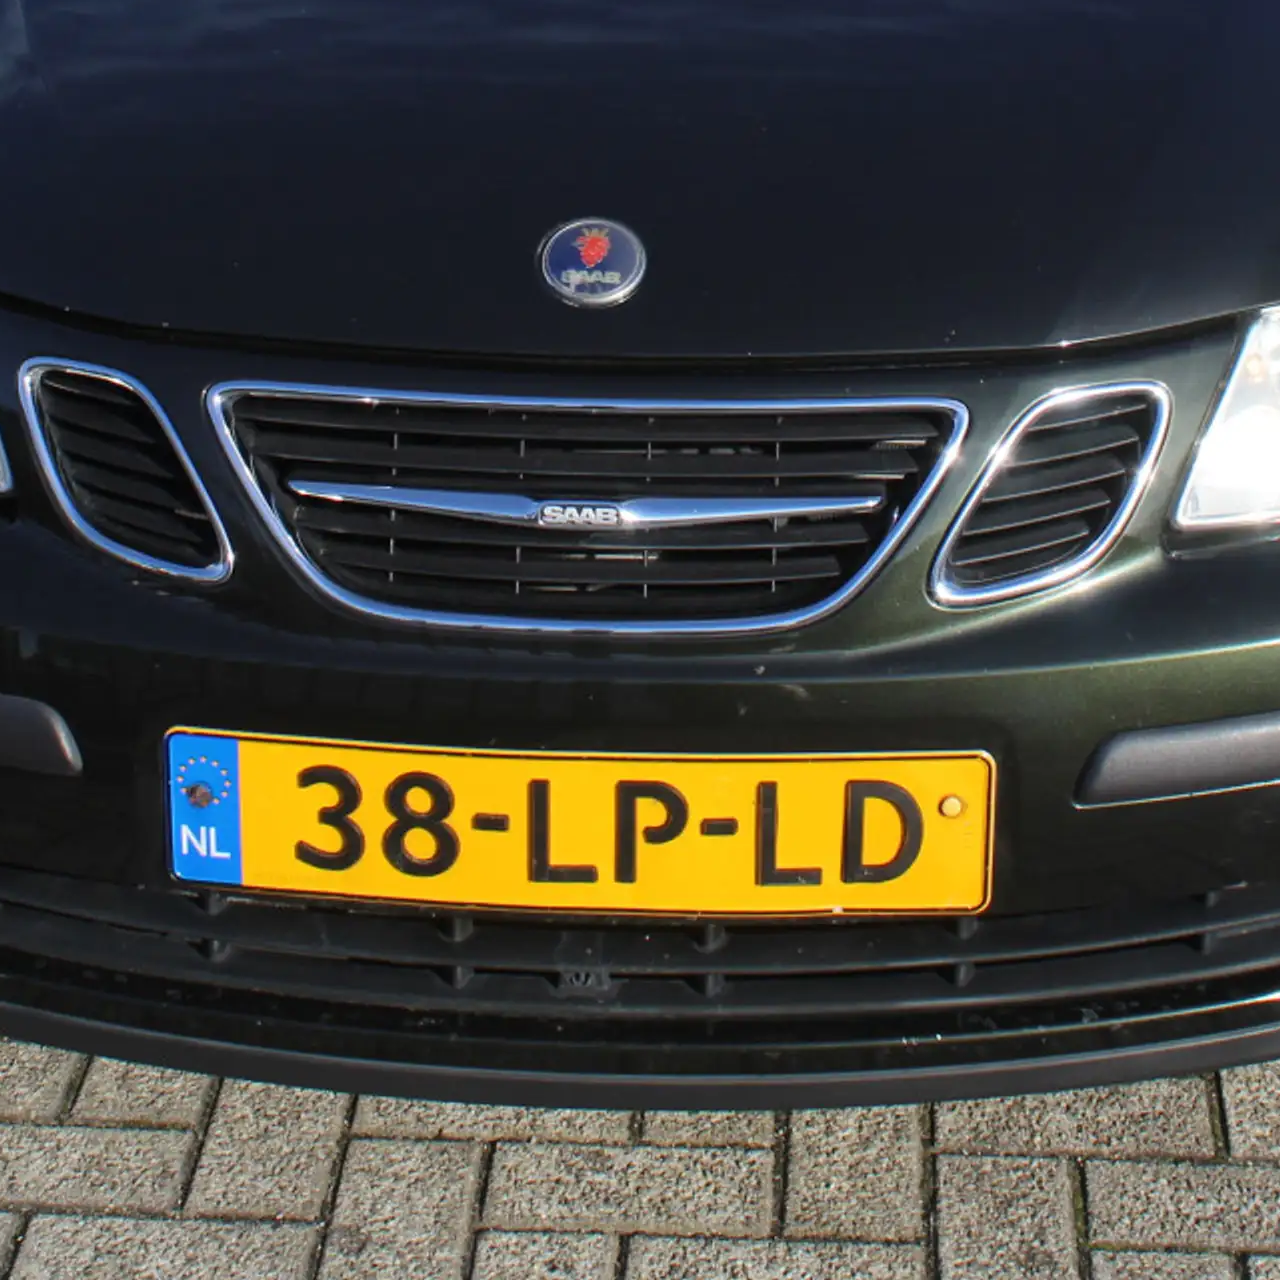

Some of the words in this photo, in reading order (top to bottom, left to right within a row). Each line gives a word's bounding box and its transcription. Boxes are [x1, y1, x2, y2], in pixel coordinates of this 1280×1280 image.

[562, 269, 621, 285] SAAB
[543, 506, 618, 525] SAAB
[294, 764, 925, 886] 38-LP-LD
[180, 824, 232, 859] NL
